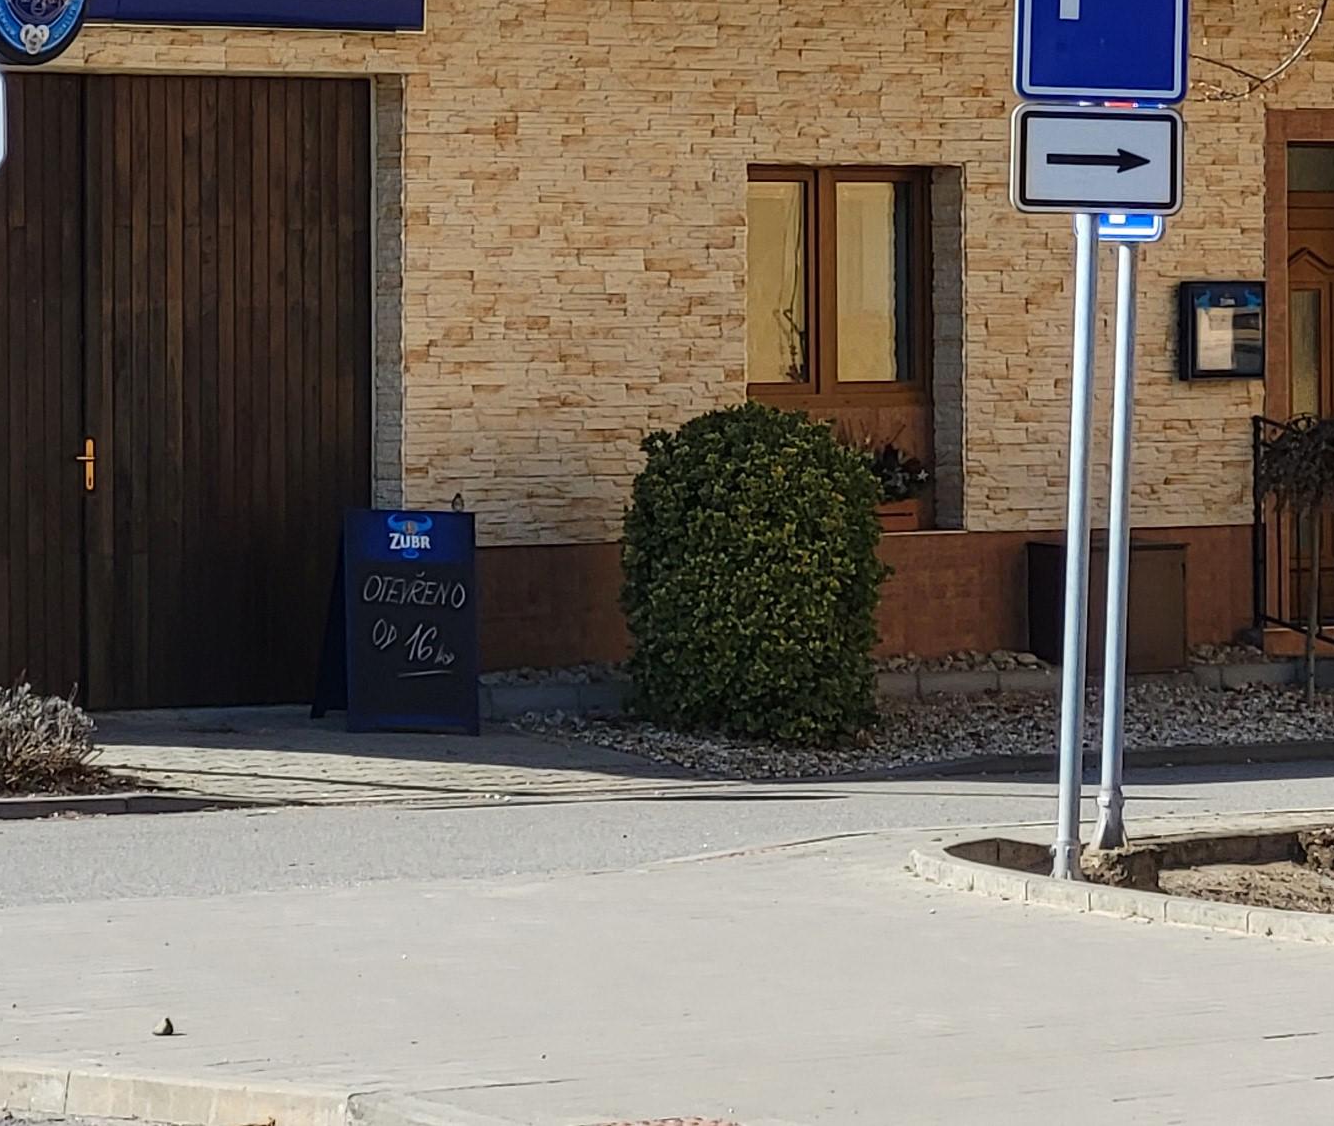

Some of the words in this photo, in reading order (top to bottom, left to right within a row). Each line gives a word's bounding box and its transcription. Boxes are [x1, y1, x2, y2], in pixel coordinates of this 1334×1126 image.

[389, 533, 431, 550] ZUBR
[363, 571, 466, 609] OTEVŘENO
[372, 618, 398, 650] OD
[404, 623, 437, 661] 16
